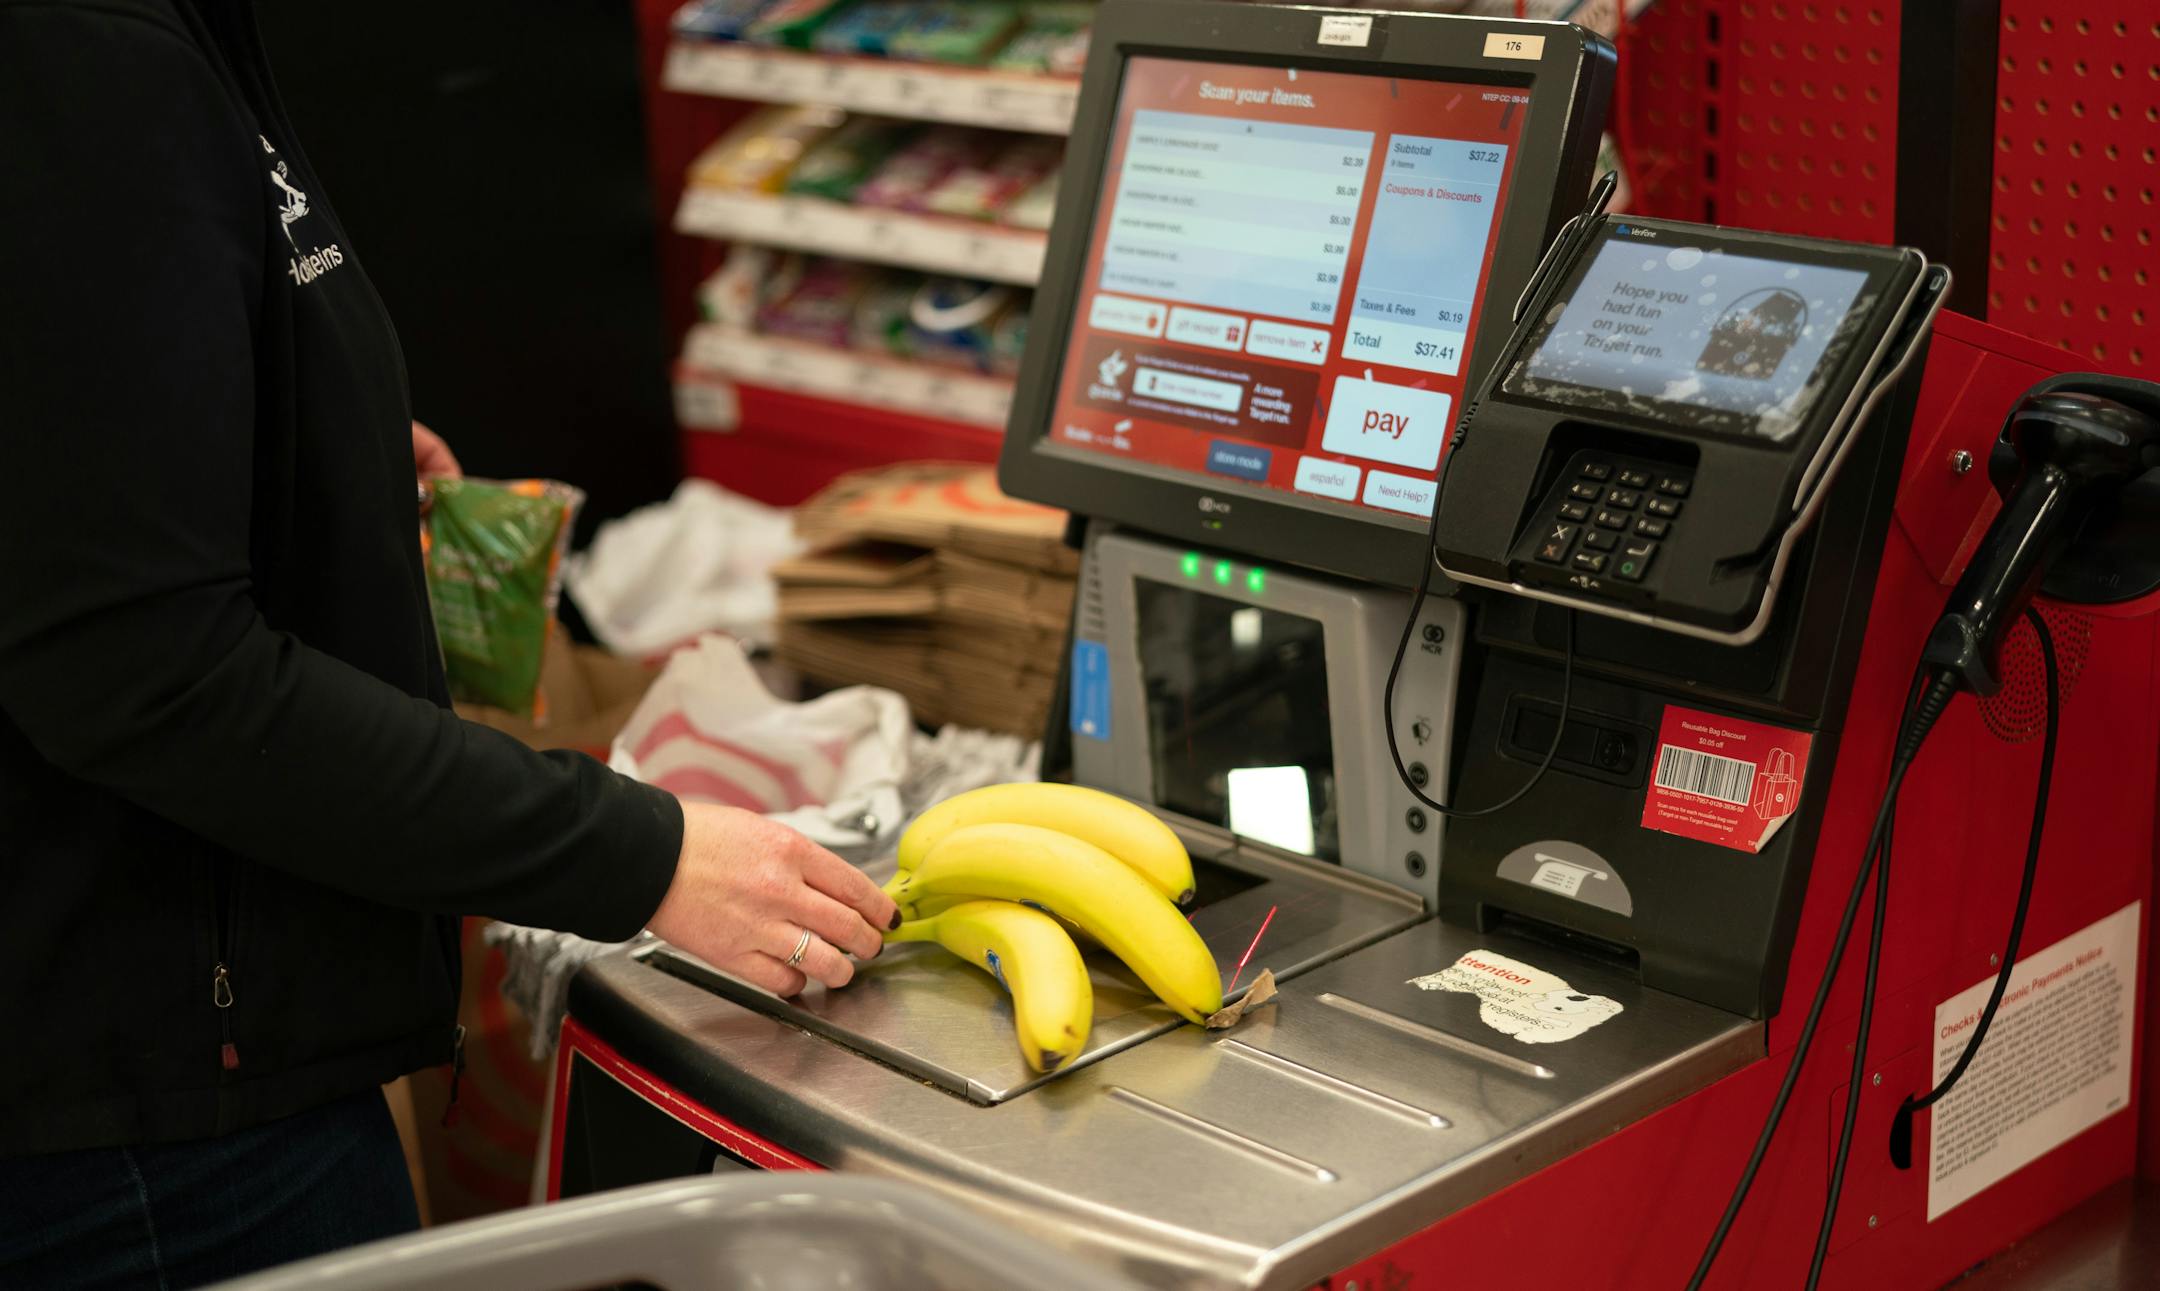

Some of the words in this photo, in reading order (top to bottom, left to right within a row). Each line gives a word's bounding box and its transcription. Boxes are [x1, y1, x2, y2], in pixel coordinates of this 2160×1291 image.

[1505, 41, 1521, 52] 176
[1199, 81, 1234, 100] Scan
[1235, 87, 1269, 105] your
[1271, 88, 1315, 107] items.
[1394, 143, 1432, 156] Subtotal
[1468, 150, 1499, 163] $37.22
[1385, 183, 1424, 198] Coupons
[1427, 188, 1433, 198] &
[1436, 189, 1482, 204] Discounts
[1612, 281, 1655, 300] Hope
[1656, 291, 1688, 304] you
[1360, 299, 1384, 313] Taxes
[1386, 304, 1392, 314] &
[1394, 305, 1416, 317] Fees
[1438, 310, 1463, 323] $0.19
[1602, 298, 1635, 315] had
[1635, 304, 1662, 319] fun
[1592, 319, 1613, 330] on
[1613, 322, 1653, 336] your
[1353, 332, 1382, 349] Total
[1414, 342, 1454, 361] $37.41
[1583, 332, 1632, 353] Target
[1632, 344, 1663, 358] run.
[1362, 409, 1408, 439] pay
[1309, 473, 1345, 488] español
[1378, 484, 1402, 499] Need
[1403, 490, 1429, 505] Help?
[1420, 642, 1442, 656] NCR
[1681, 721, 1708, 735] Reusable
[1708, 726, 1720, 738] Bag
[1721, 729, 1746, 742] Discount
[1698, 737, 1715, 748] $0.05
[1716, 741, 1724, 749] off
[1459, 955, 1532, 986] ttention
[1498, 996, 1516, 1005] at
[1503, 987, 1529, 999] not
[1940, 1015, 1975, 1041] Checks
[2032, 964, 2074, 991] Payments
[2076, 946, 2103, 968] Notice
